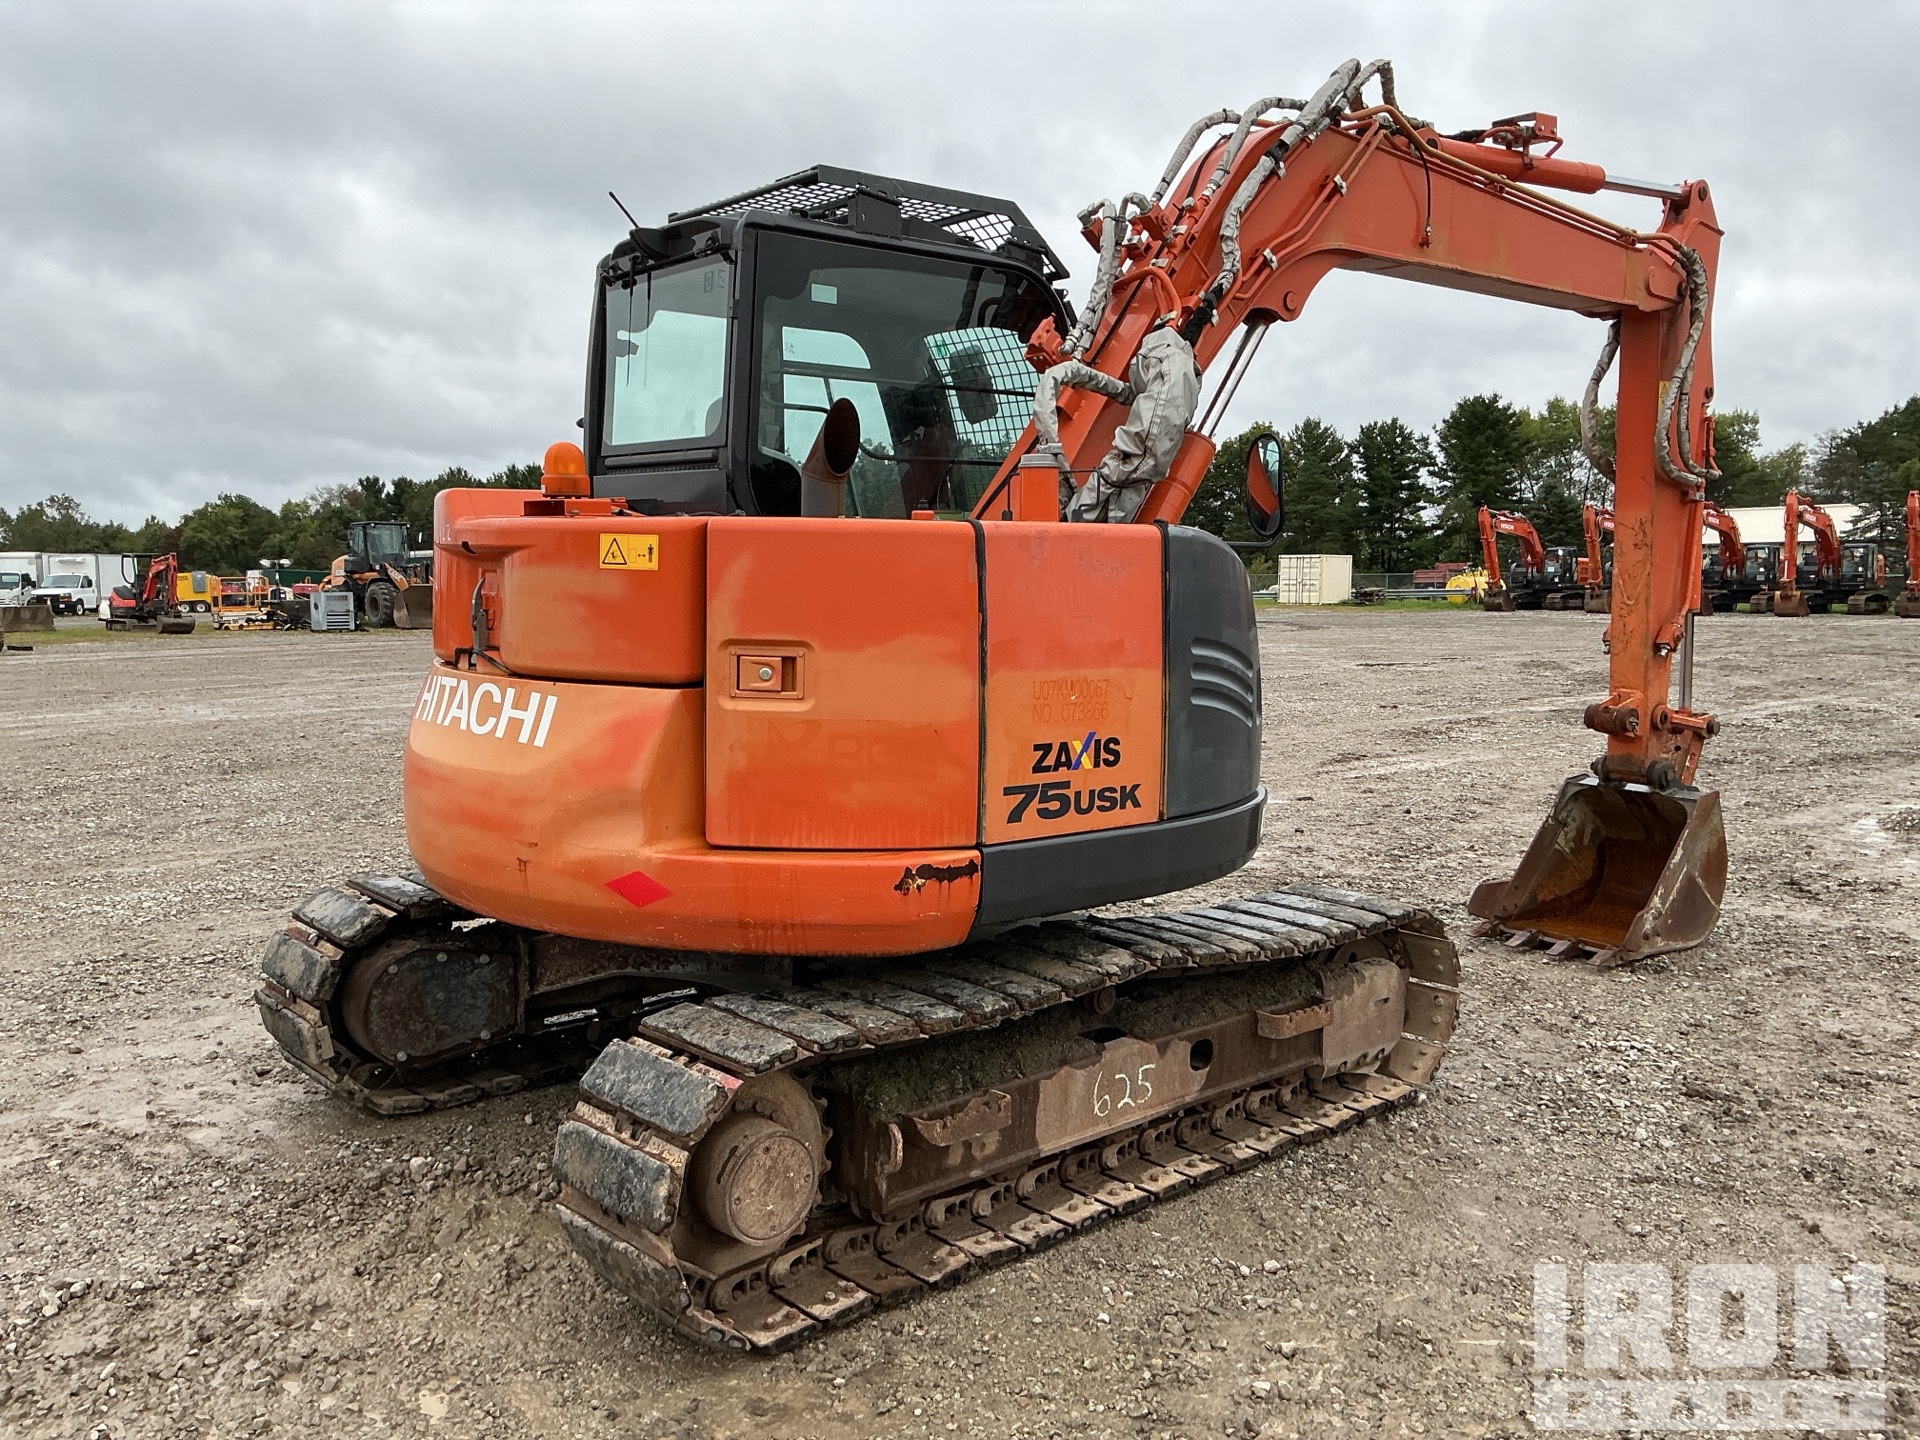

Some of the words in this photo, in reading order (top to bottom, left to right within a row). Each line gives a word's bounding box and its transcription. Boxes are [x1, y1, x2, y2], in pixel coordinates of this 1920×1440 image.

[415, 674, 558, 748] HITACHI
[1032, 731, 1121, 774] ZAXIS
[1093, 1064, 1156, 1117] 625
